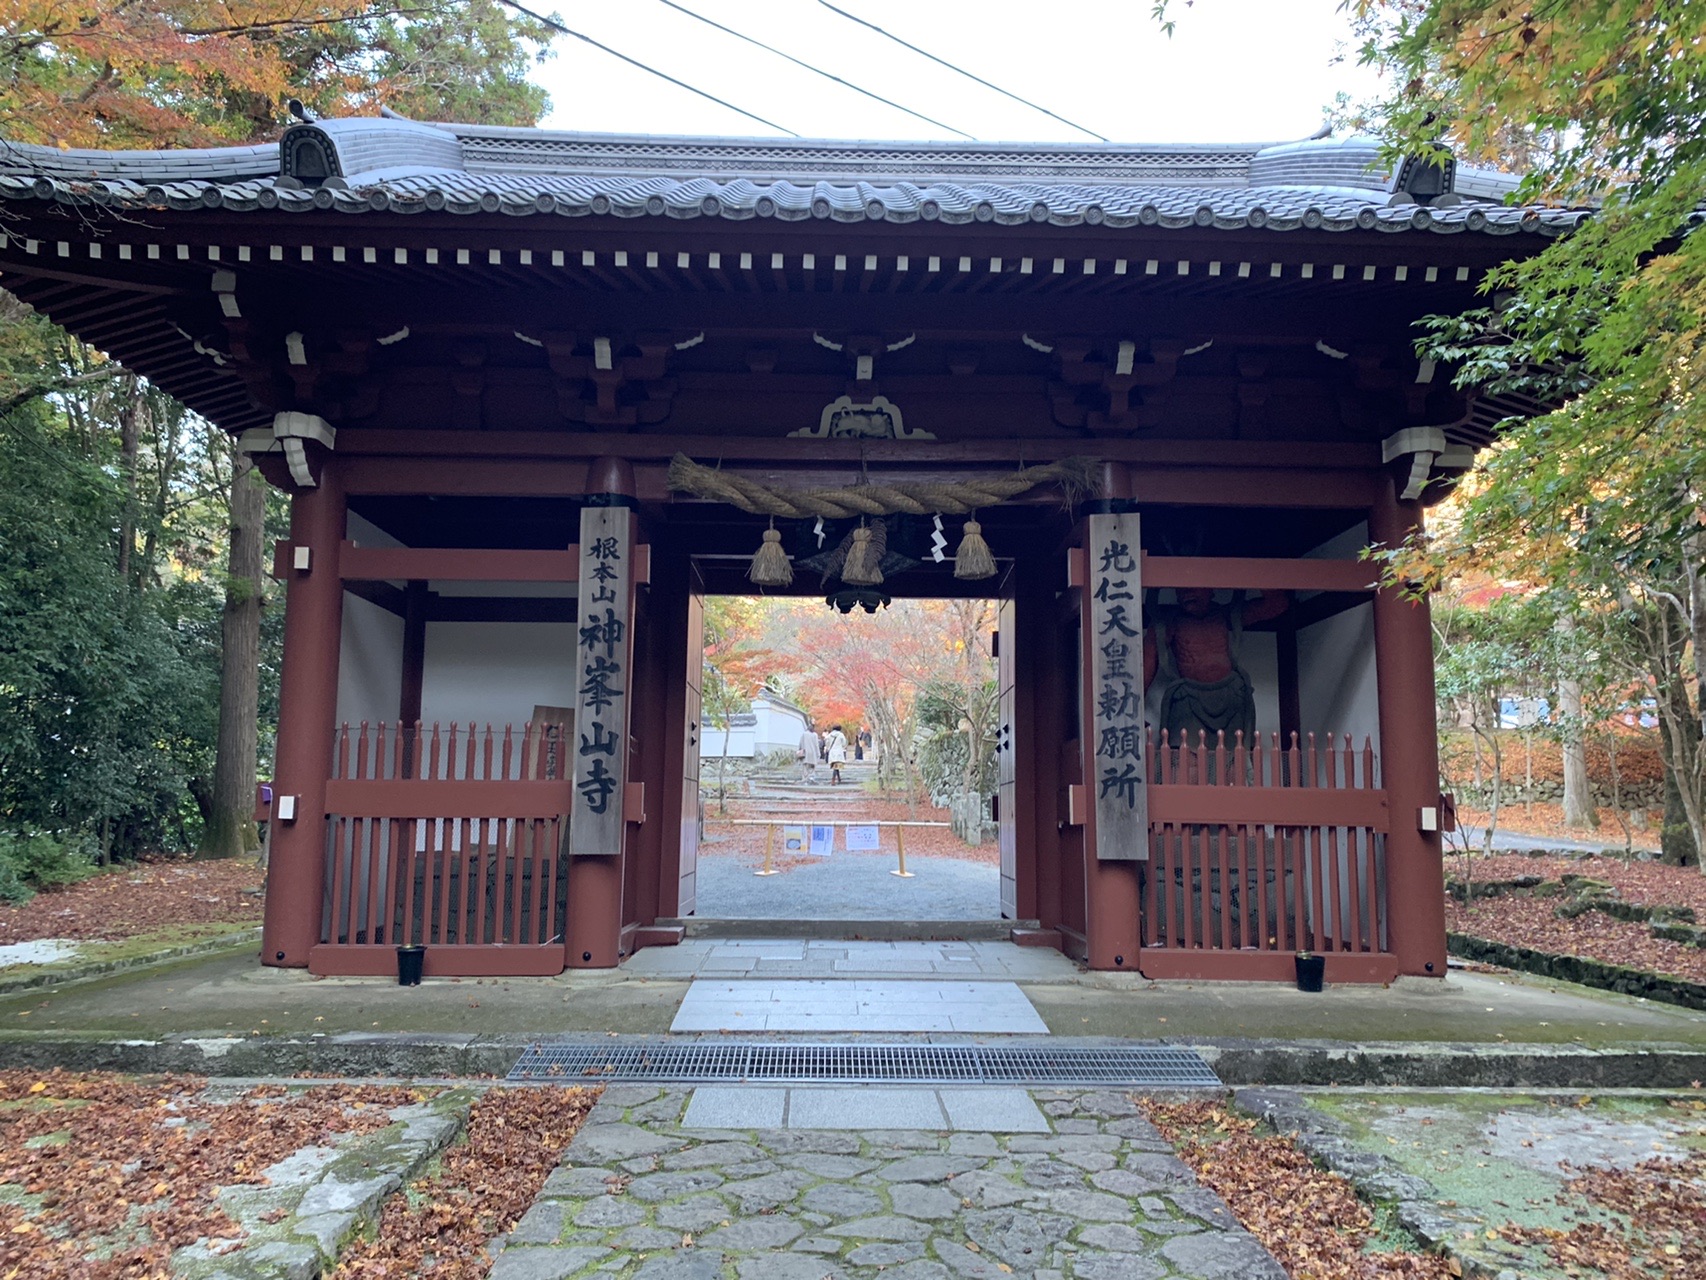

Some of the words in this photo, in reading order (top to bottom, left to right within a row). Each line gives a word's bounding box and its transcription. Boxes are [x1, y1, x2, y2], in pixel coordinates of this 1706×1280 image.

[1094, 540, 1142, 809] 光仁天皇勅願所
